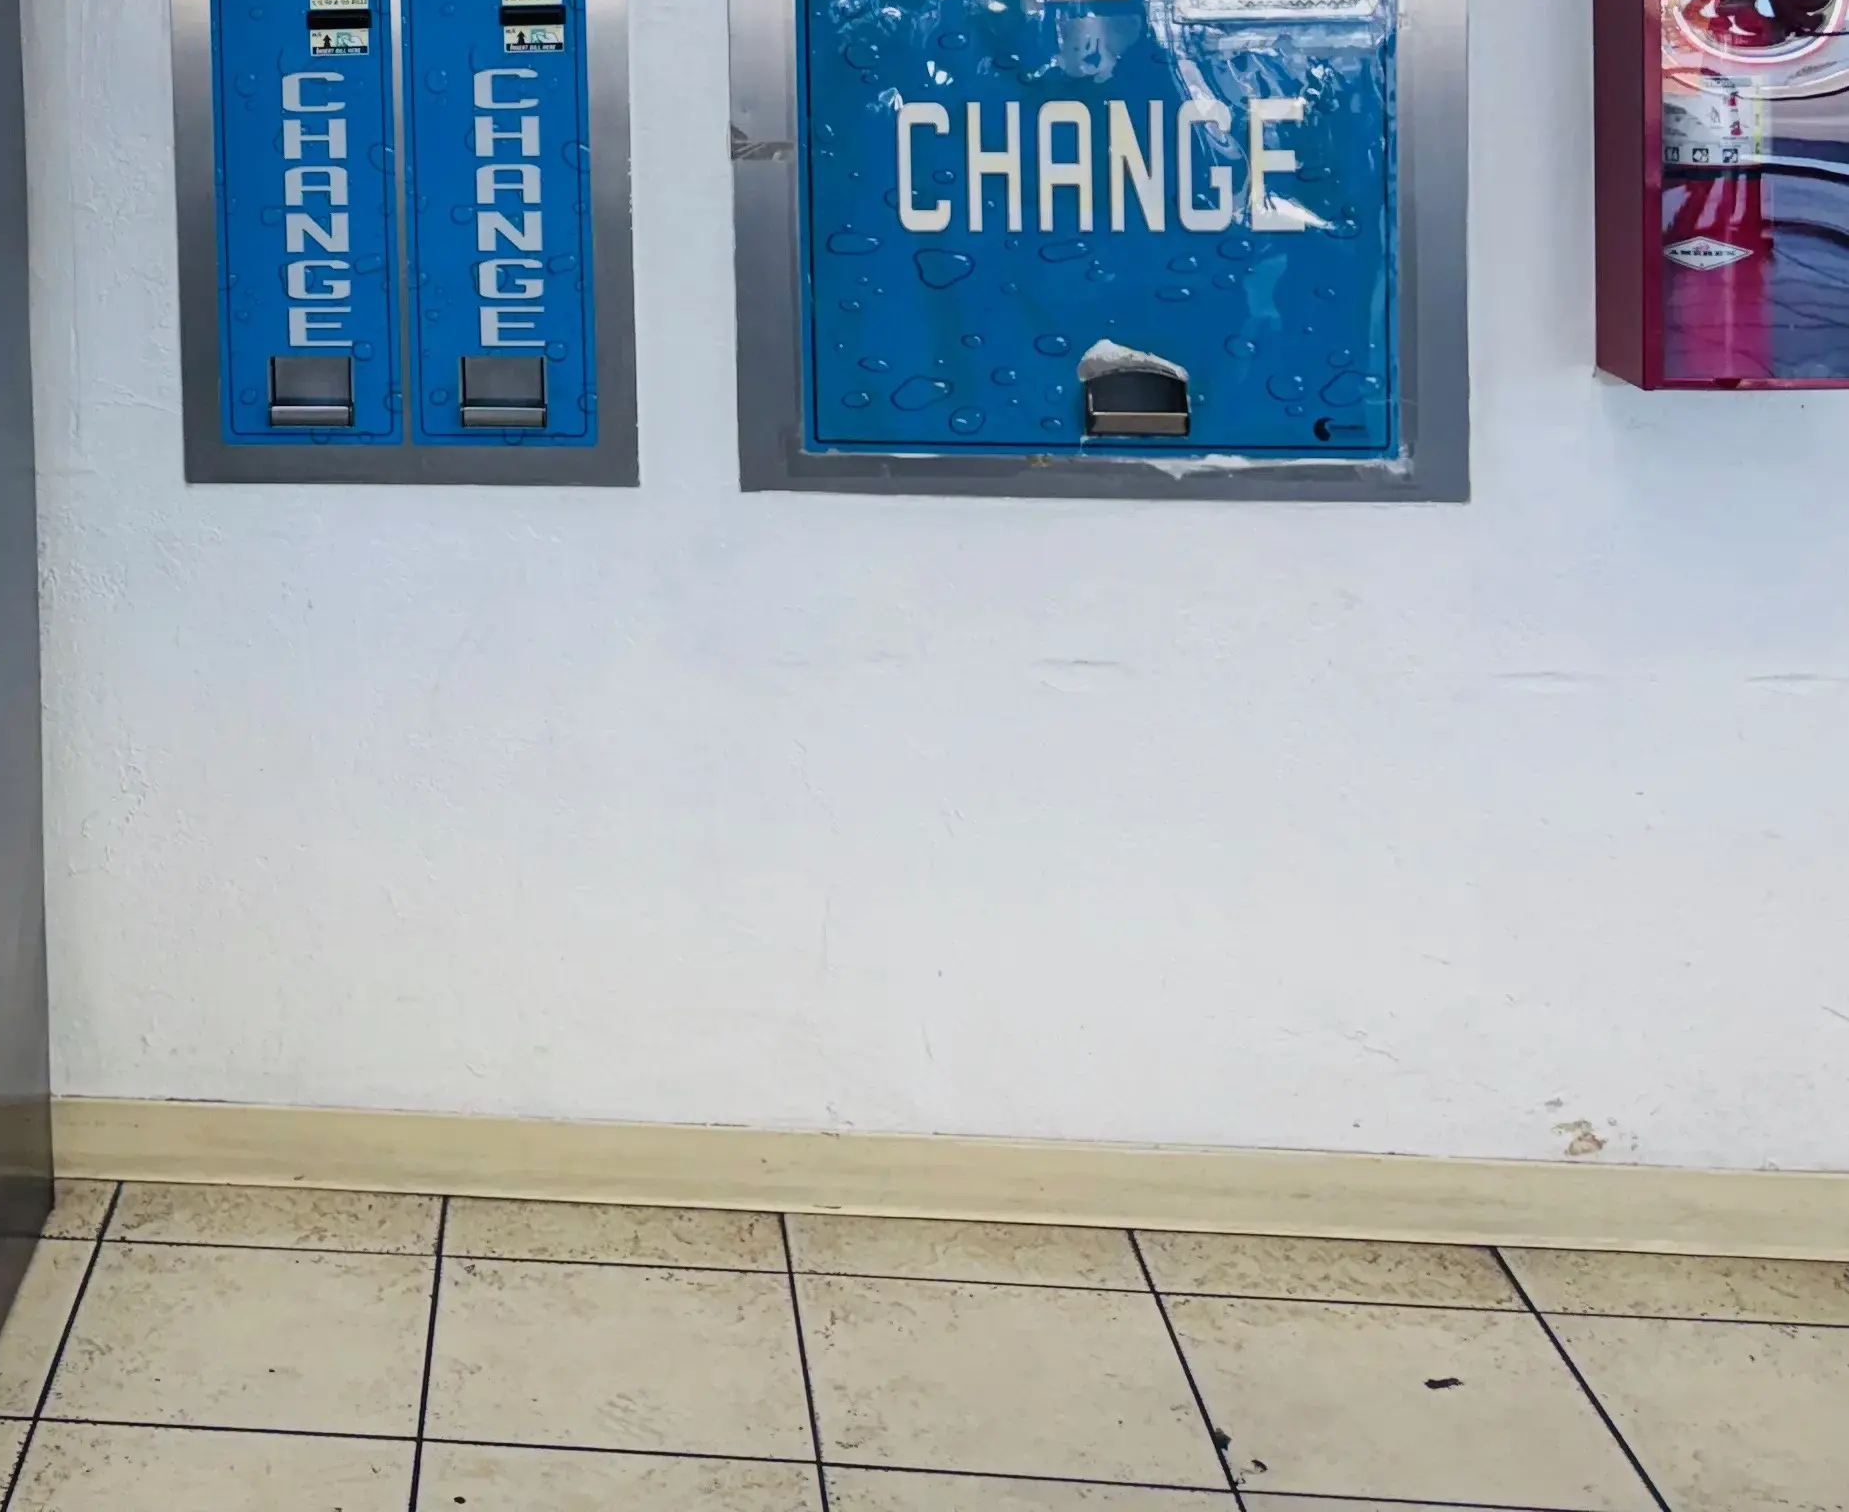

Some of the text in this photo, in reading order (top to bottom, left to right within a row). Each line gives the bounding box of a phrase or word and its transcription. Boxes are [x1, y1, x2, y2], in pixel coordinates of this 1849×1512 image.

[282, 71, 353, 347] CHANGE
[473, 68, 545, 346] CHANGE
[897, 98, 1307, 233] CHANGE
